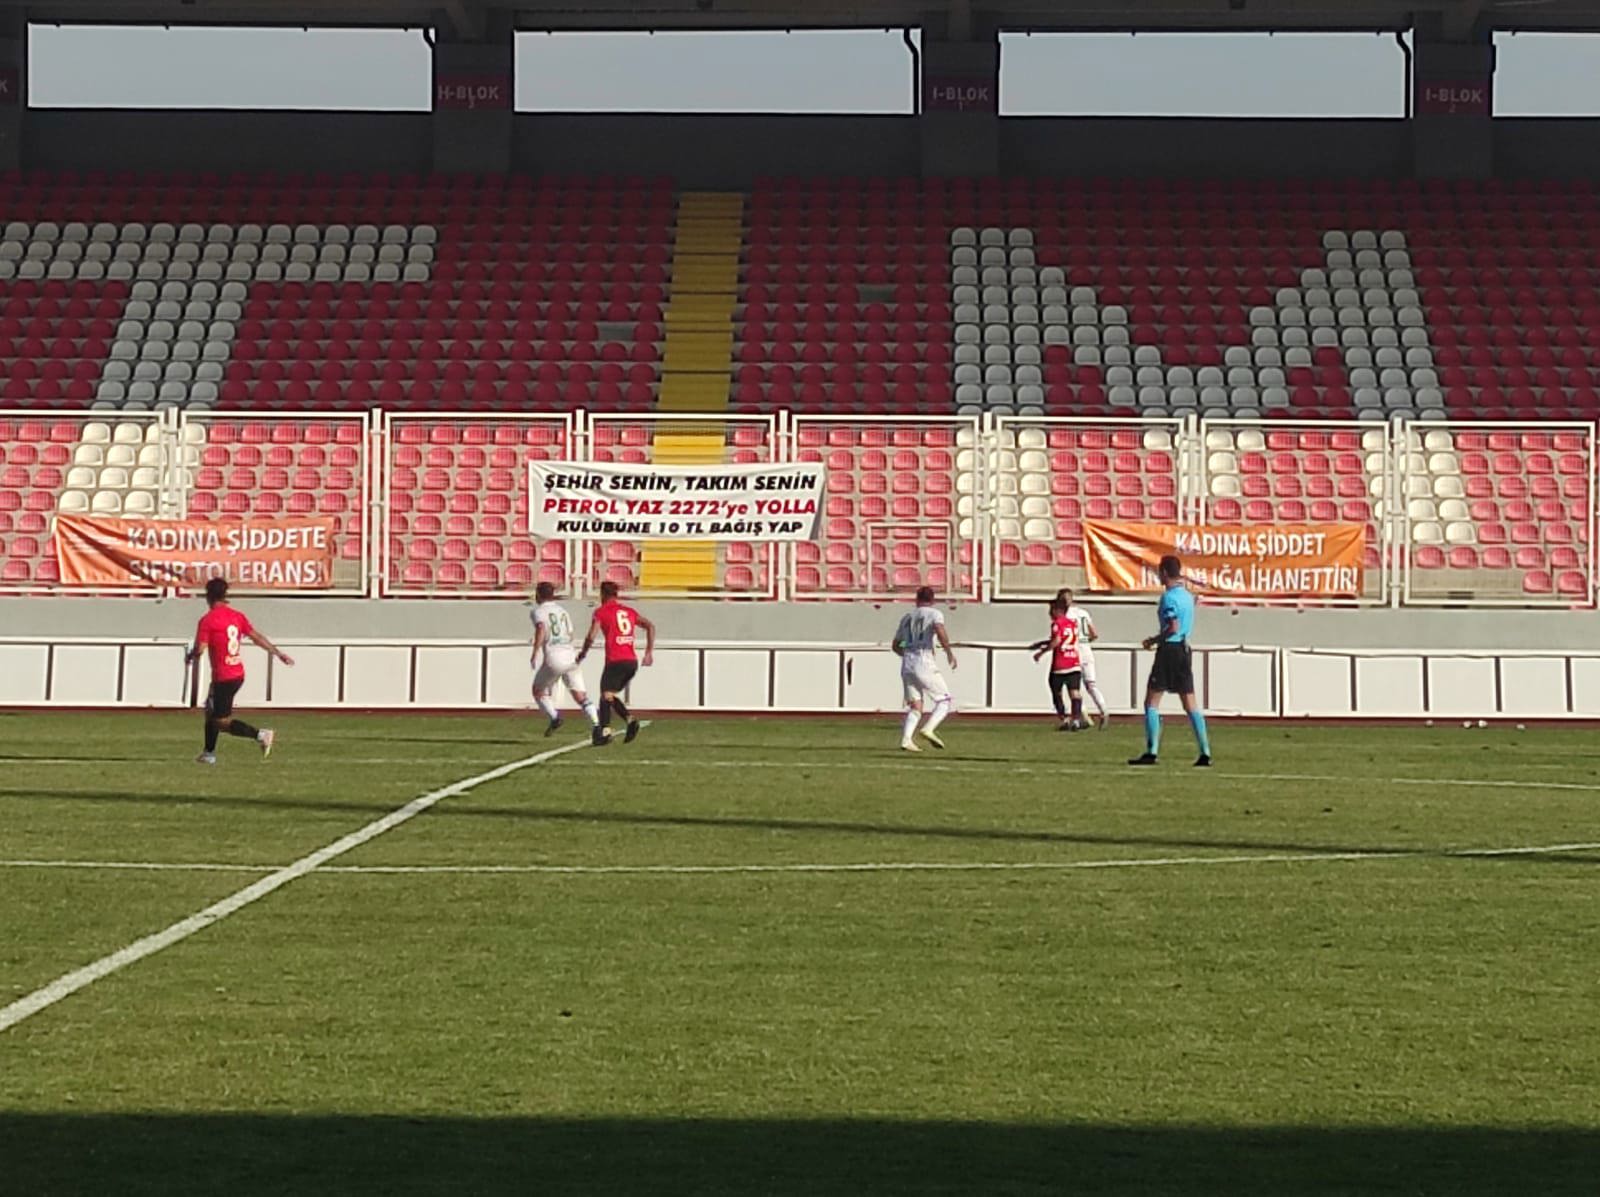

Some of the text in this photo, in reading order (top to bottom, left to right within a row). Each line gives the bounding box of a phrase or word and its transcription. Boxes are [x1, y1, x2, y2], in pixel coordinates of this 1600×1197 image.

[438, 85, 499, 100] H-BLOK
[544, 471, 817, 494] ŞEHİR SENİN, TAKIM SENİN
[543, 498, 619, 514] PETROL
[625, 499, 664, 515] YAZ
[755, 499, 816, 515] YOLLA
[127, 523, 326, 557] KADINA ŞİDDETE
[556, 518, 804, 537] KULÜBÜNE 10 TL BAĞIŞ YAP
[1174, 528, 1326, 561] KADINA ŞİDDET
[1250, 562, 1359, 592] İHANETTİR!
[616, 609, 633, 636] 6
[226, 624, 240, 656] 8
